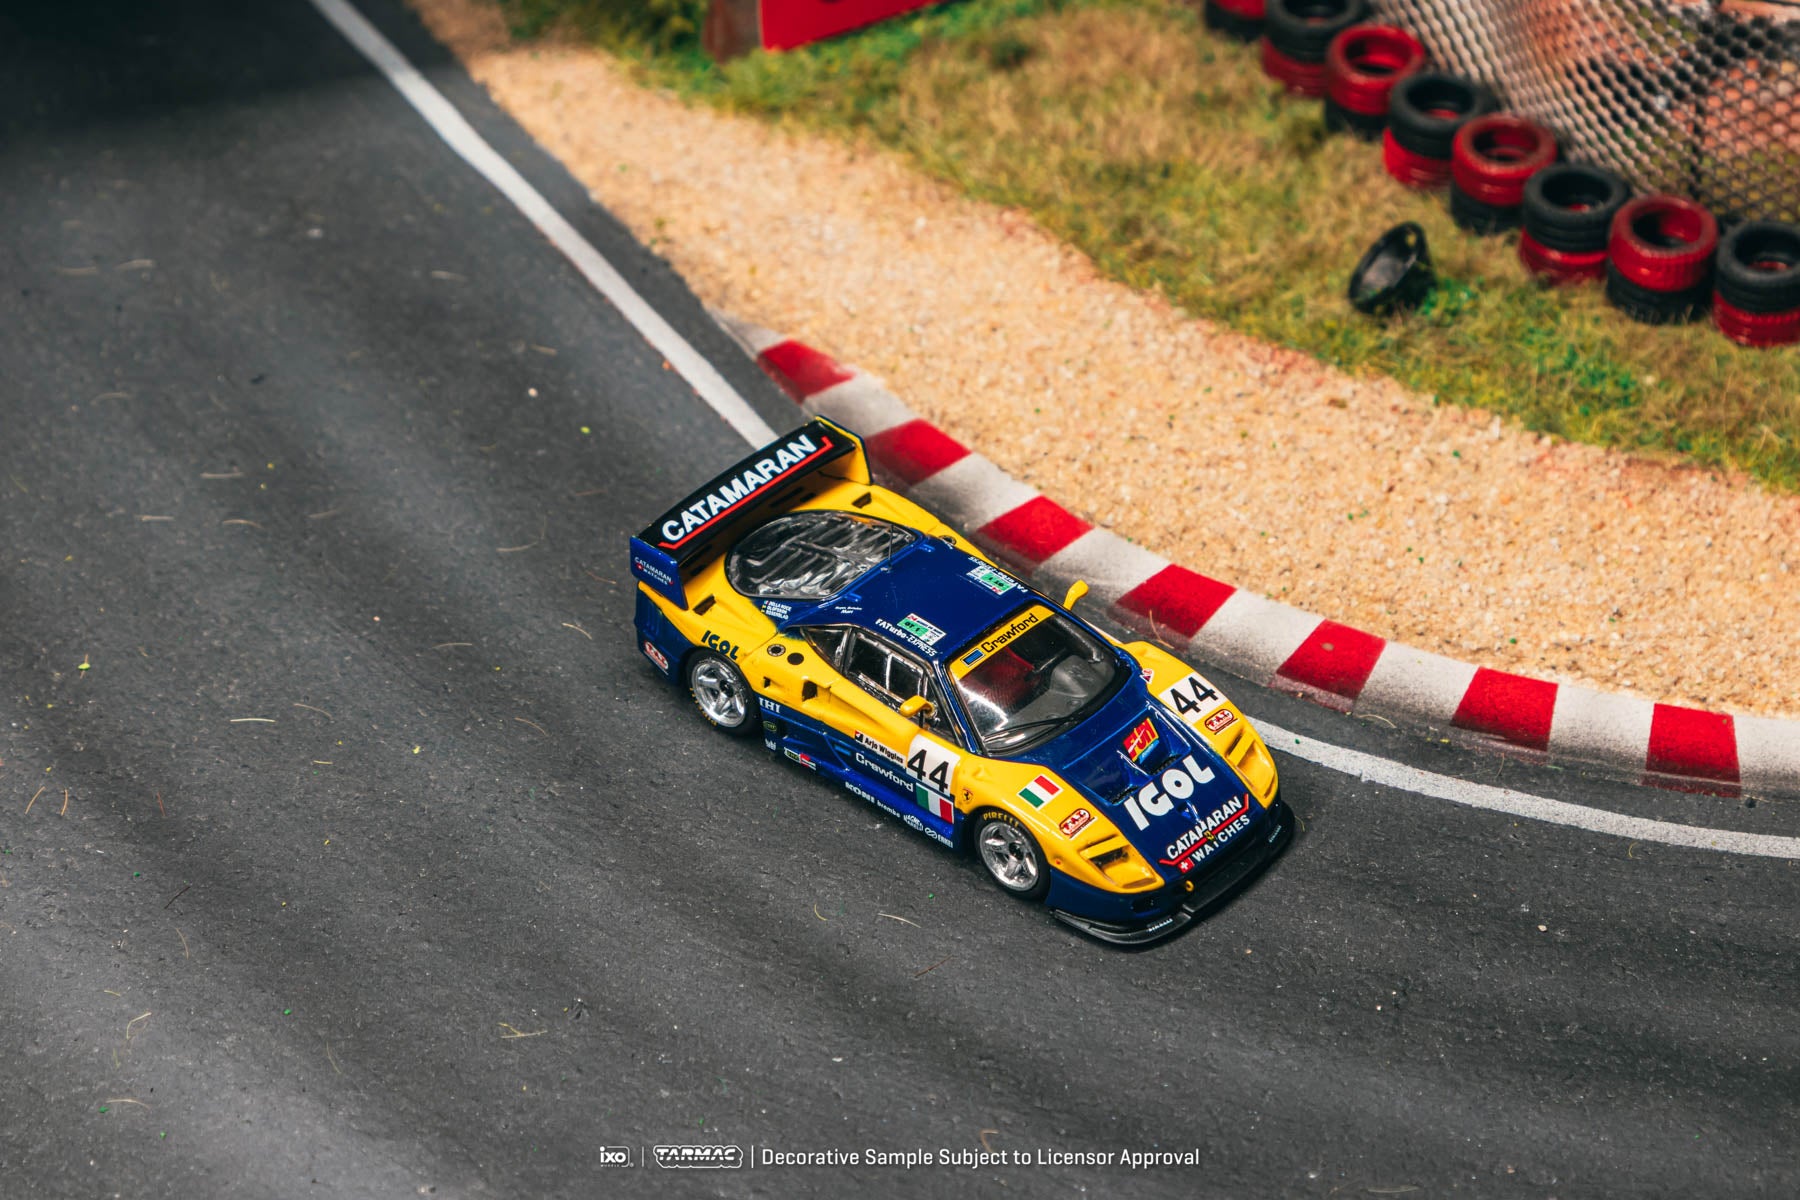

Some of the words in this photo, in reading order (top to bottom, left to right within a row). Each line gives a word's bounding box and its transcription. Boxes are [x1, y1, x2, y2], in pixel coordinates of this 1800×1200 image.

[661, 433, 817, 541] CATAMARAN
[634, 556, 672, 583] CATAMARAN
[701, 630, 740, 660] IGOL
[981, 613, 1040, 653] Crawford
[759, 697, 781, 713] IHI
[1170, 676, 1219, 715] 44
[855, 752, 914, 793] Crawford
[907, 749, 950, 794] 44
[1124, 755, 1216, 832] IGOL
[1166, 795, 1243, 860] CATAMARAN
